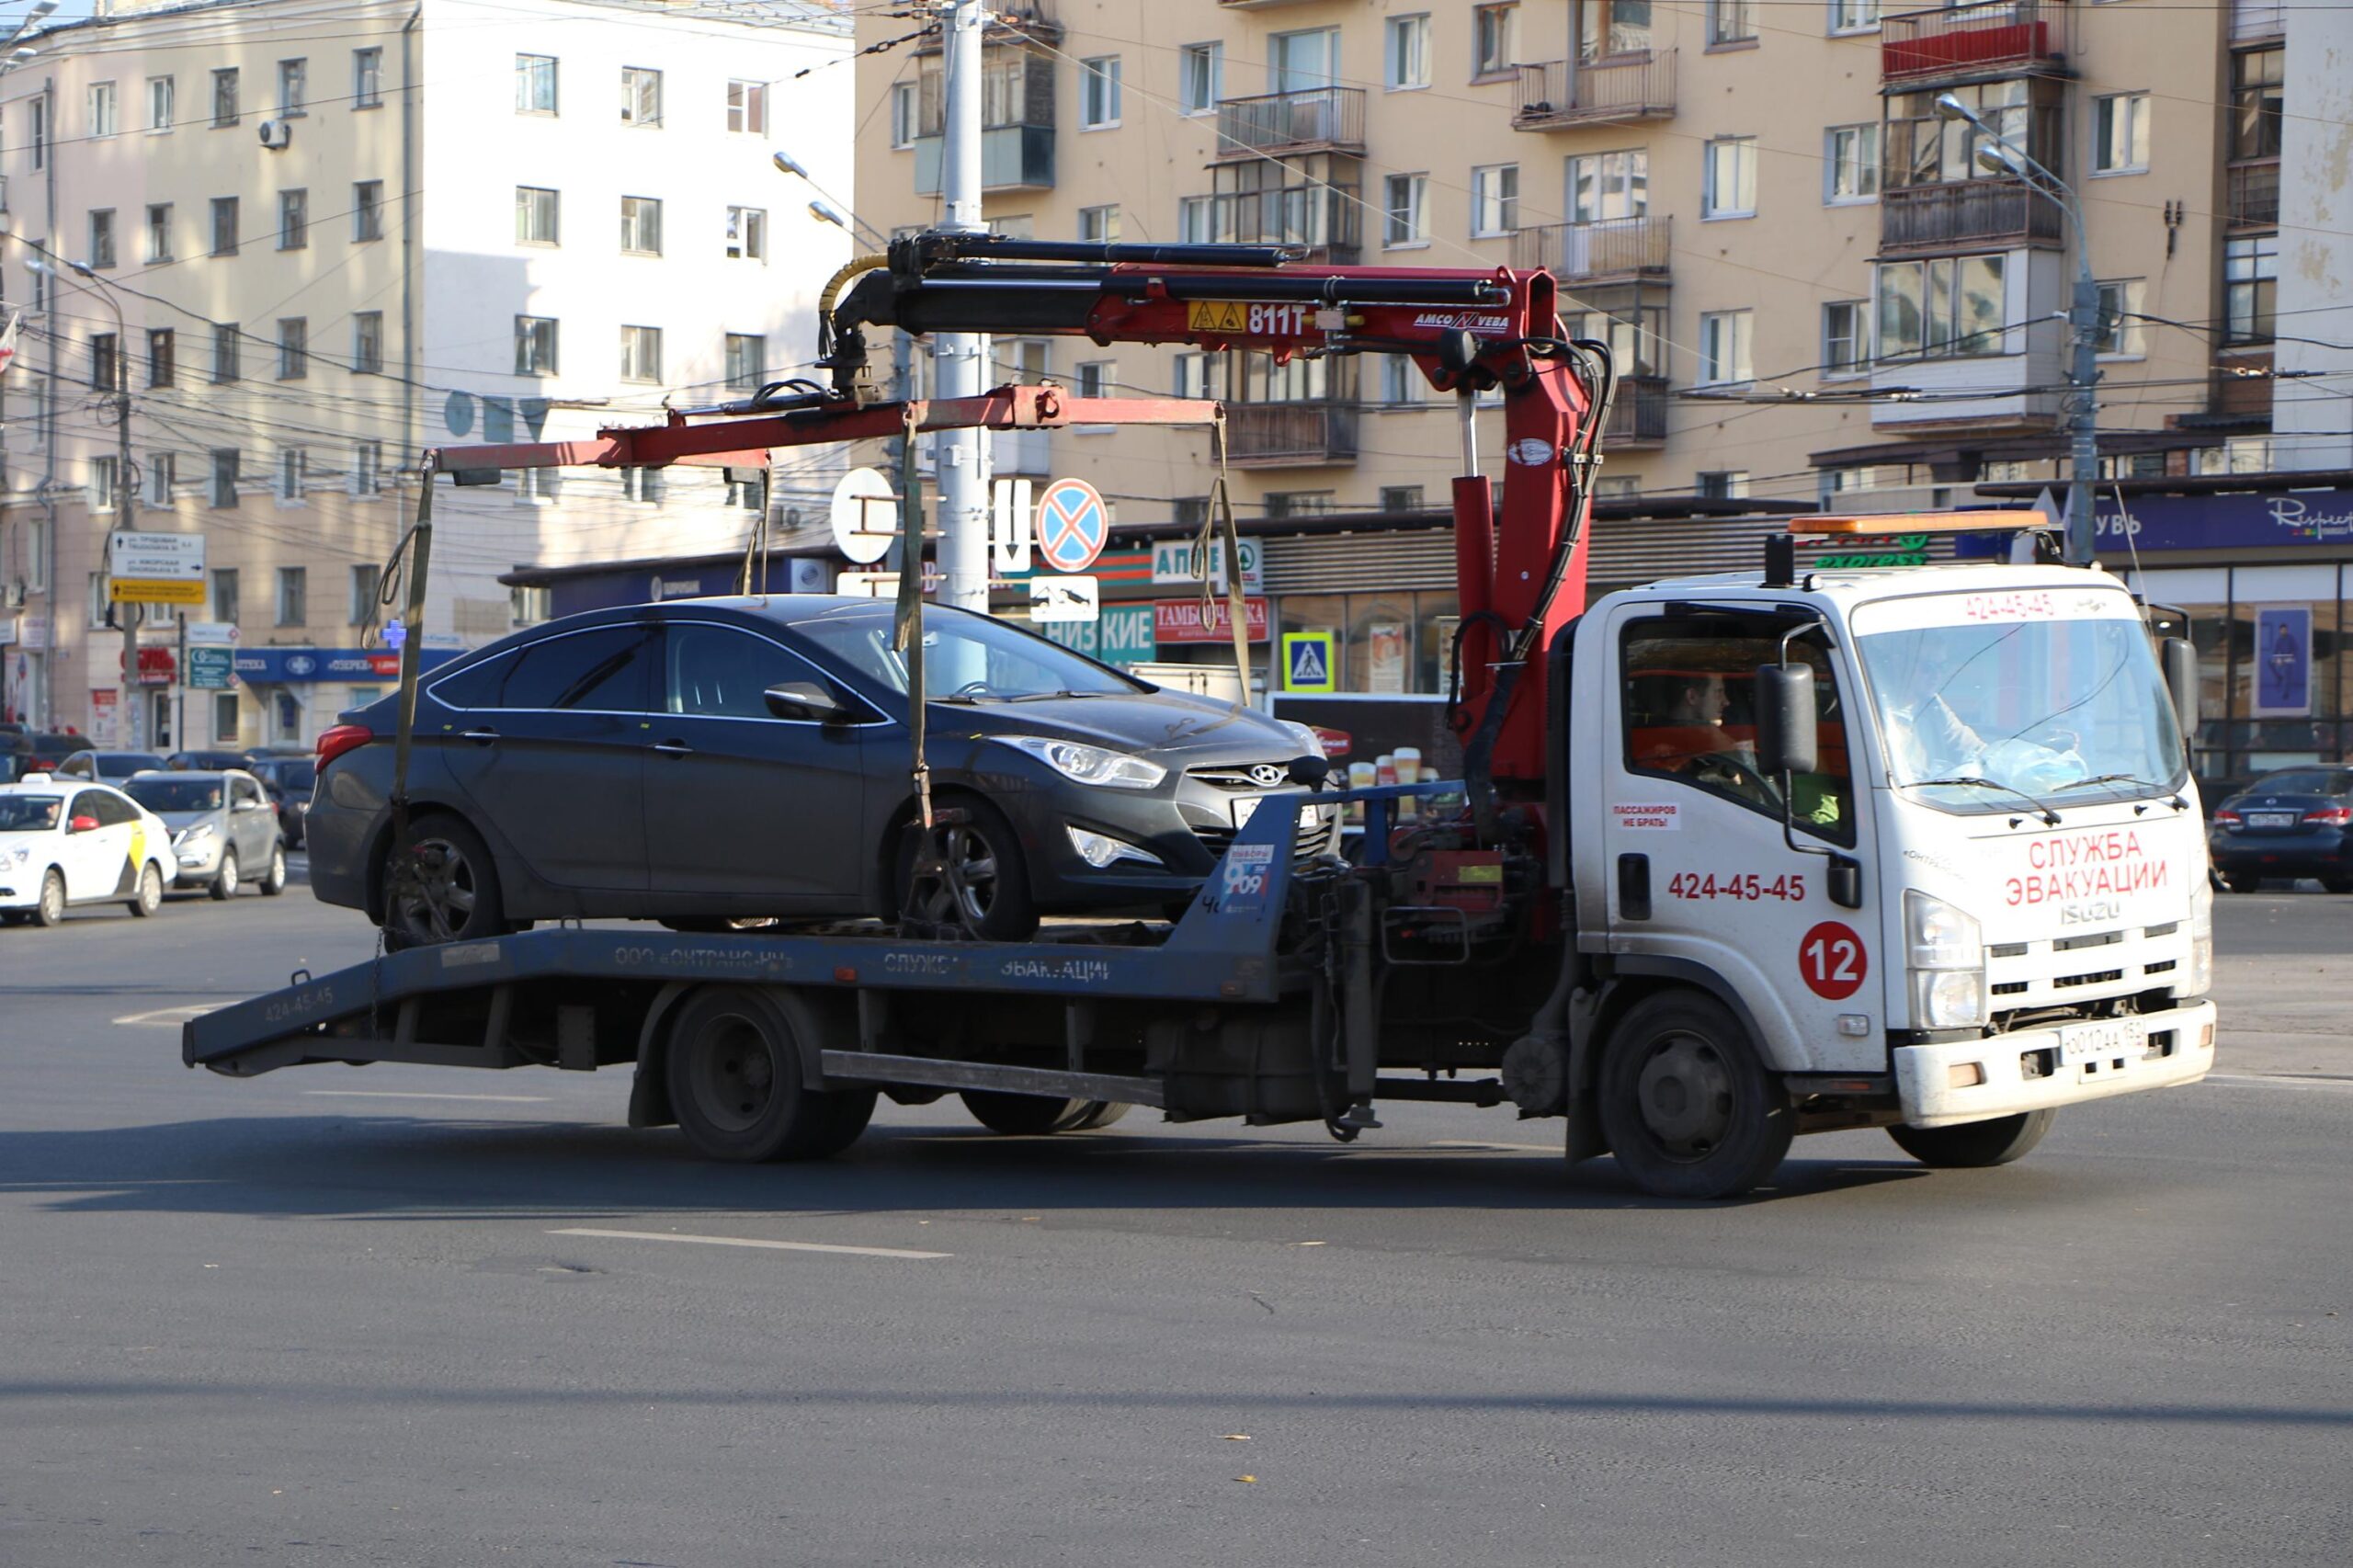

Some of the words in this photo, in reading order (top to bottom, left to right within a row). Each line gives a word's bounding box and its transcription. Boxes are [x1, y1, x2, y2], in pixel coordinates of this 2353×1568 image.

[1249, 304, 1306, 335] 811T
[1415, 313, 1454, 325] AMCO
[1477, 316, 1509, 327] VEBA
[2096, 514, 2143, 536] УВЬ
[1814, 552, 1927, 569] express
[1967, 594, 2054, 619] 424-45-45
[1613, 805, 1677, 815] ПАССАЖИРОВ
[1622, 818, 1634, 826] НЕ
[1637, 818, 1668, 827] БРАТЬ!
[2029, 830, 2143, 869] СЛУЖБА
[1668, 873, 1806, 902] 424-45-45
[2006, 859, 2167, 906] ЭВАКУАЦИИ
[2061, 901, 2120, 925] ISUZU
[1806, 938, 1859, 981] 12
